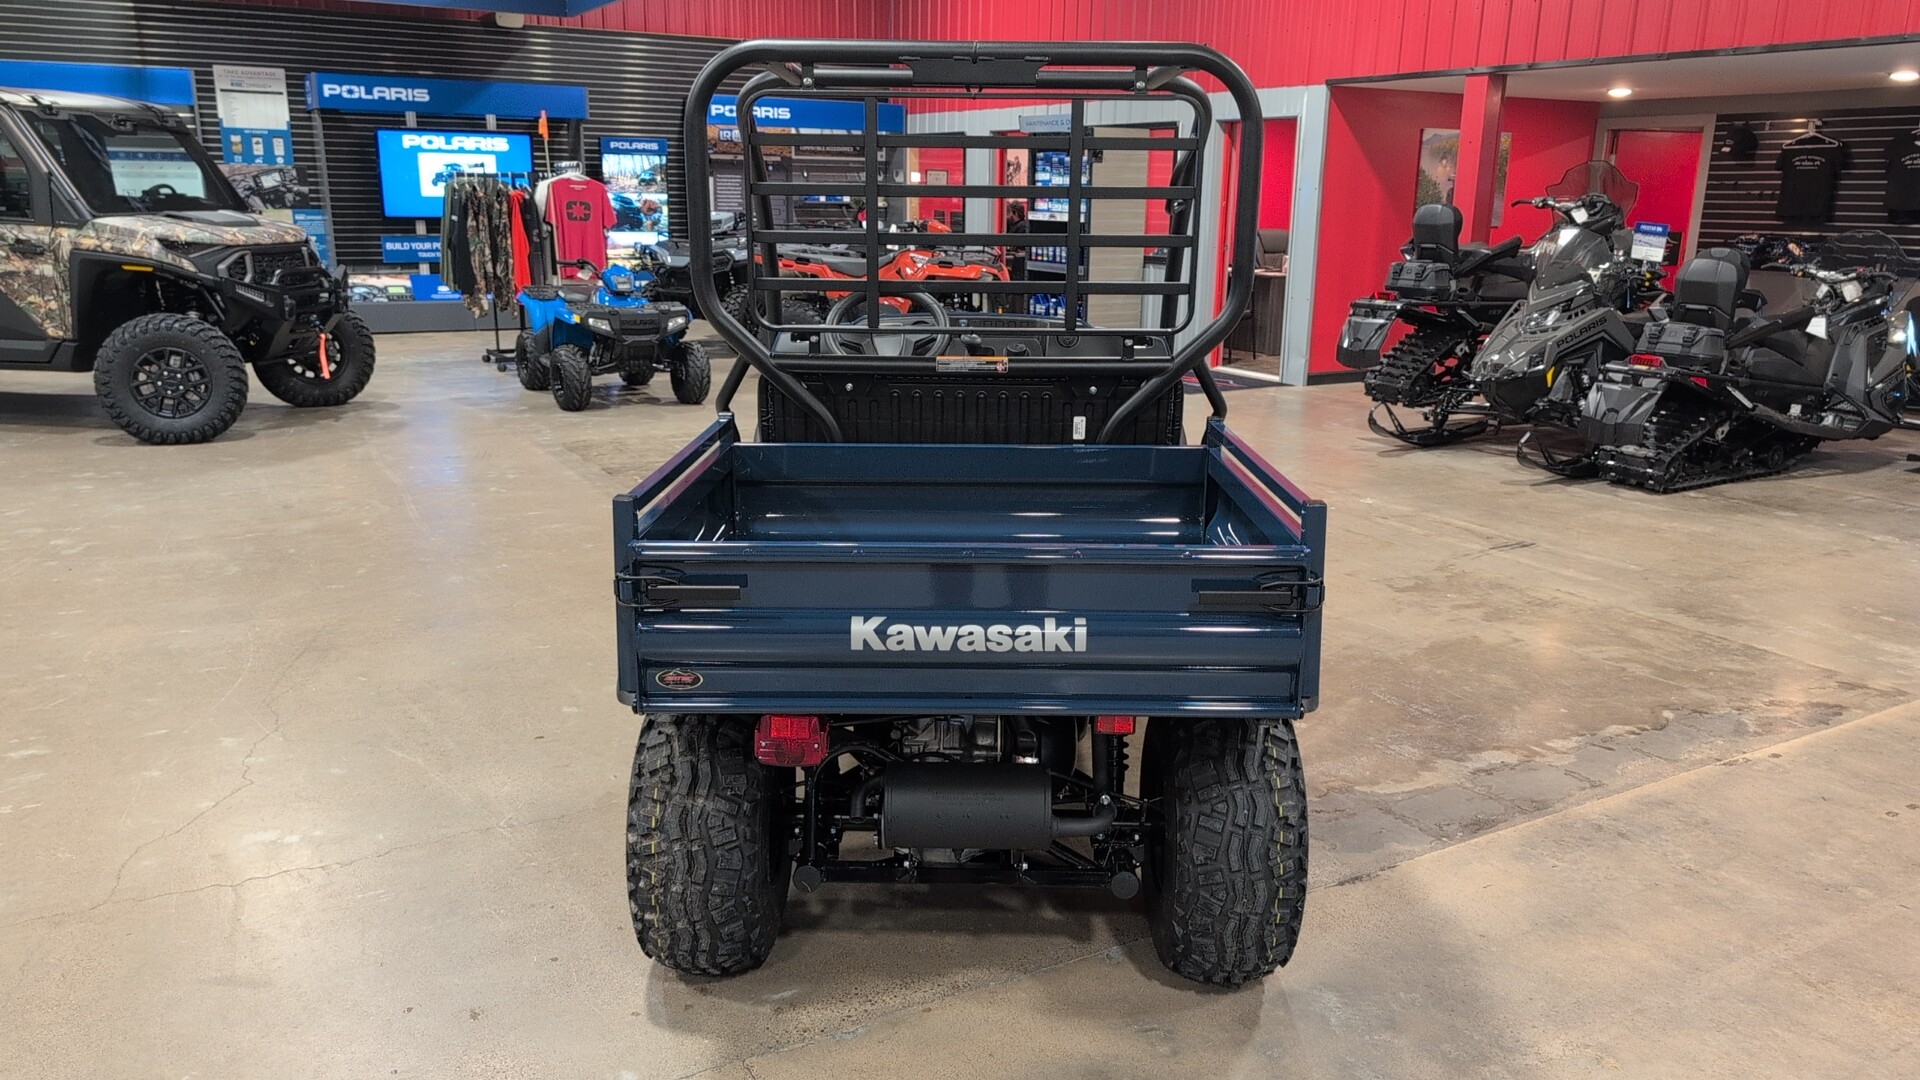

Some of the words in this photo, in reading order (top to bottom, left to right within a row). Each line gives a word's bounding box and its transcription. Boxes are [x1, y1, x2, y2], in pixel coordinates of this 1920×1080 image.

[323, 83, 430, 103] POLARIS
[710, 104, 792, 120] POARIS
[402, 134, 510, 152] POLARIS
[610, 141, 659, 151] POLARIS
[385, 242, 410, 250] BUILD
[410, 242, 433, 250] YOUR
[1556, 316, 1607, 348] POLARIS
[850, 615, 1088, 652] Kawasaki
